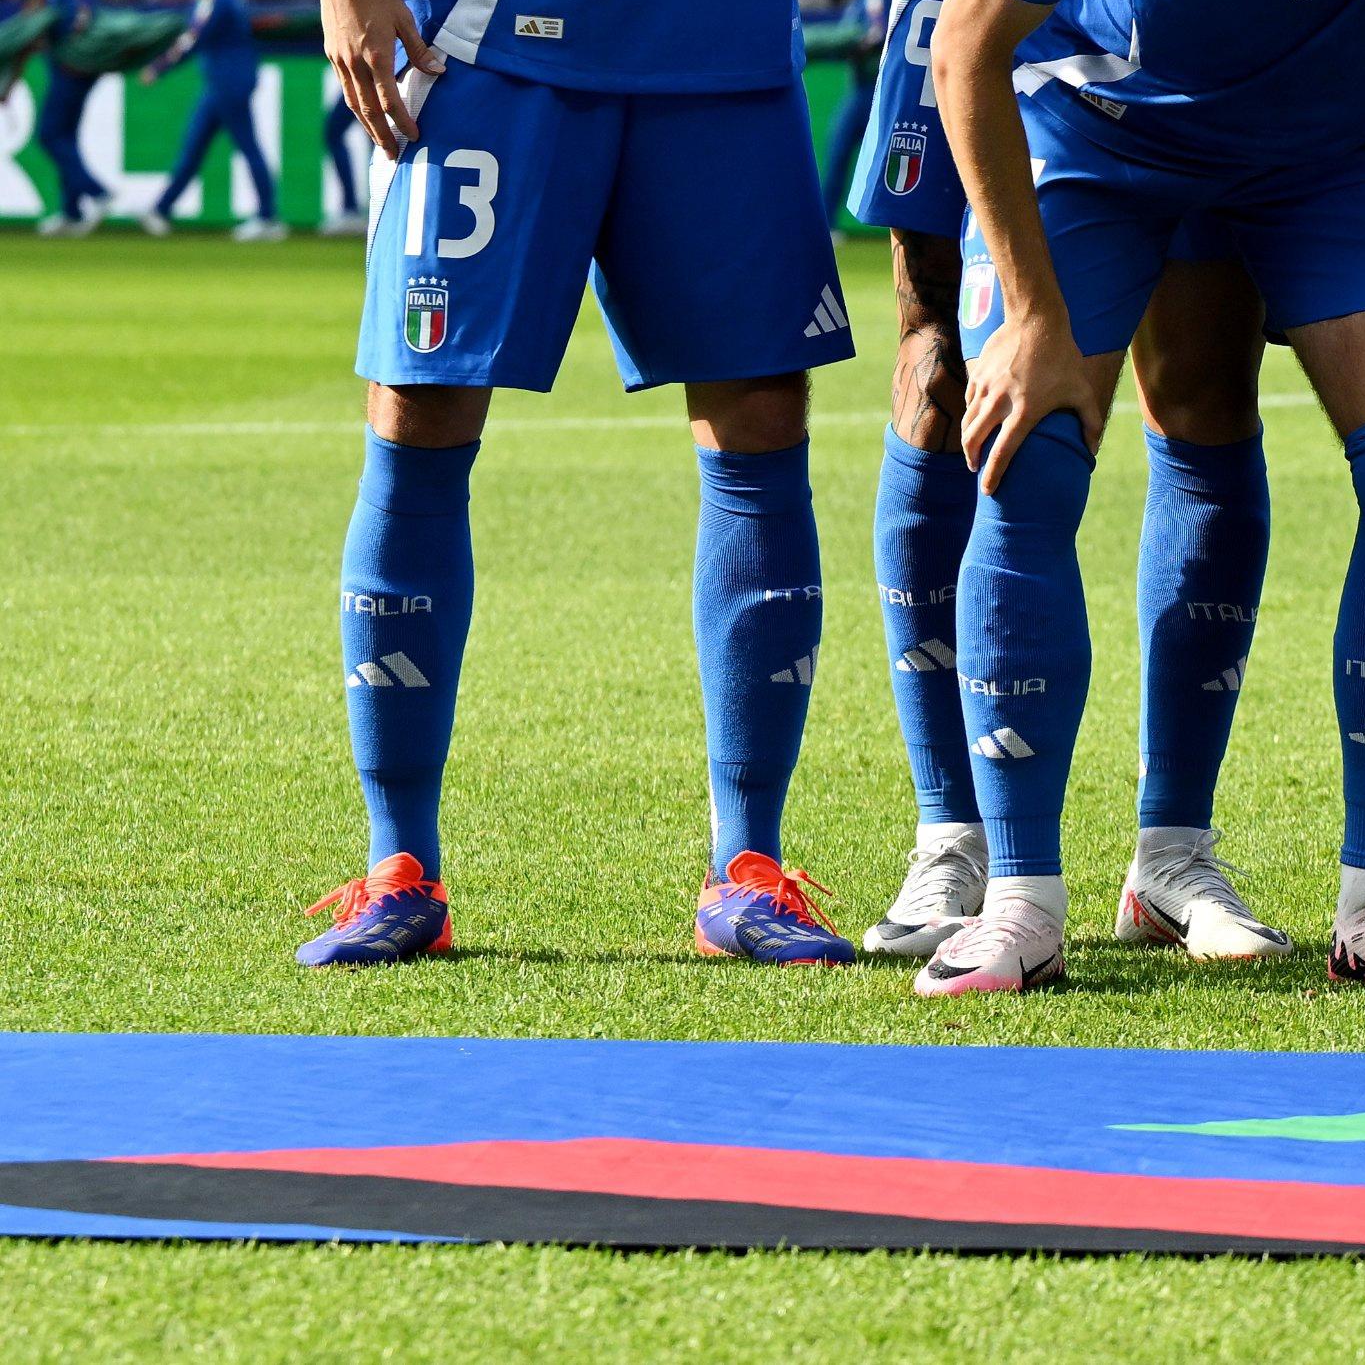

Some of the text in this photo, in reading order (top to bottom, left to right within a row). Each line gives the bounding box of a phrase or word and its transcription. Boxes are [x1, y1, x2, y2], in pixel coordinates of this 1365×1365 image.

[892, 136, 923, 151] ITALIA
[403, 146, 499, 258] 13
[410, 293, 444, 305] ITALIA
[342, 591, 432, 616] TALIA
[957, 671, 1046, 695] TALIA
